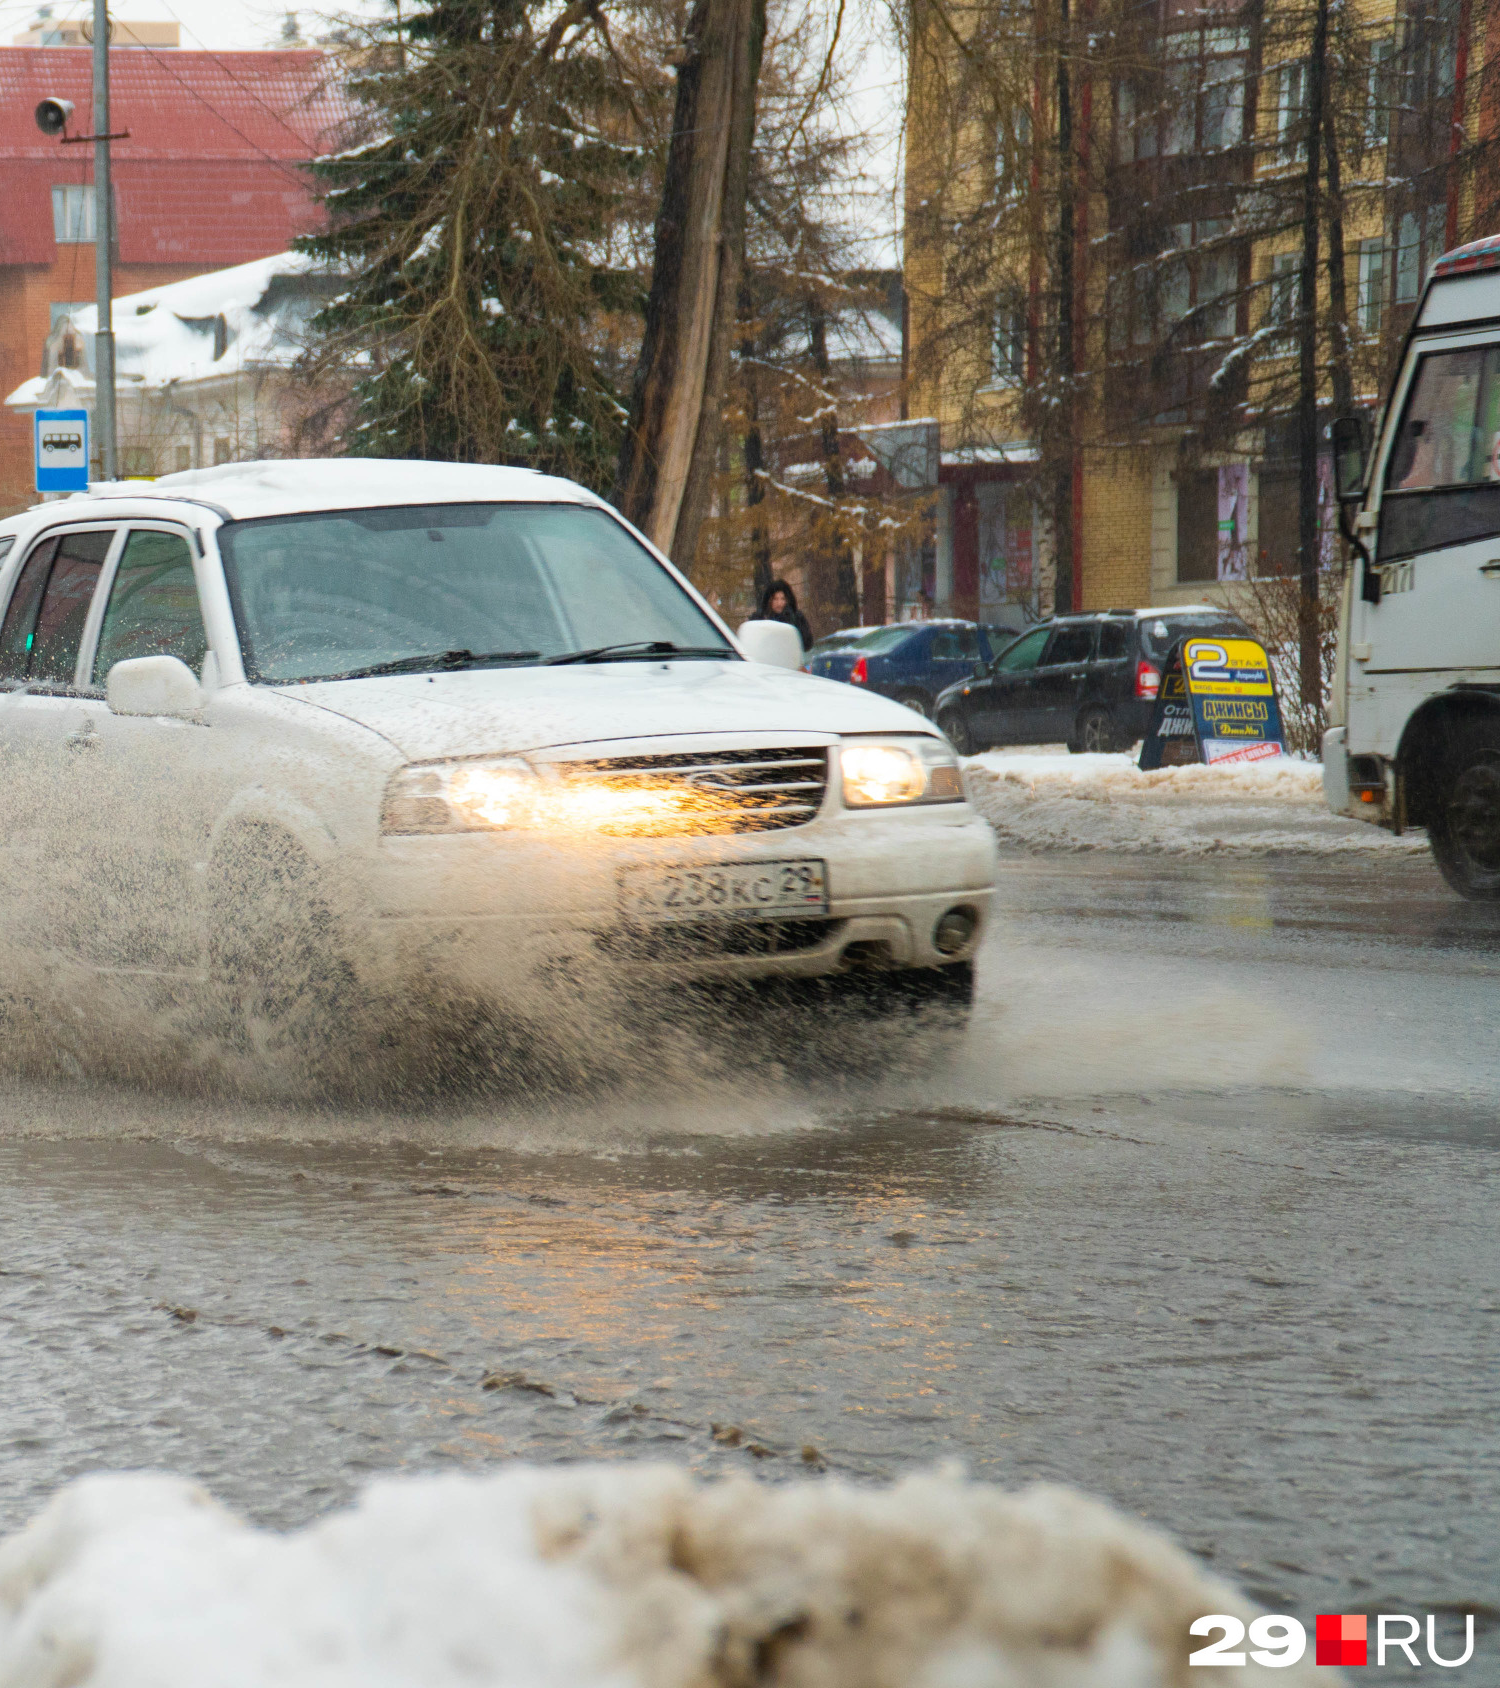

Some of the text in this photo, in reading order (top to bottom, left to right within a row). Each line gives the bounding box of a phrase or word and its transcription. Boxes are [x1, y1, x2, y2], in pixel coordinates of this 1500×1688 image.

[1189, 643, 1231, 679] 2
[1203, 700, 1268, 719] ДЖИНСЫ
[780, 866, 815, 893] 29
